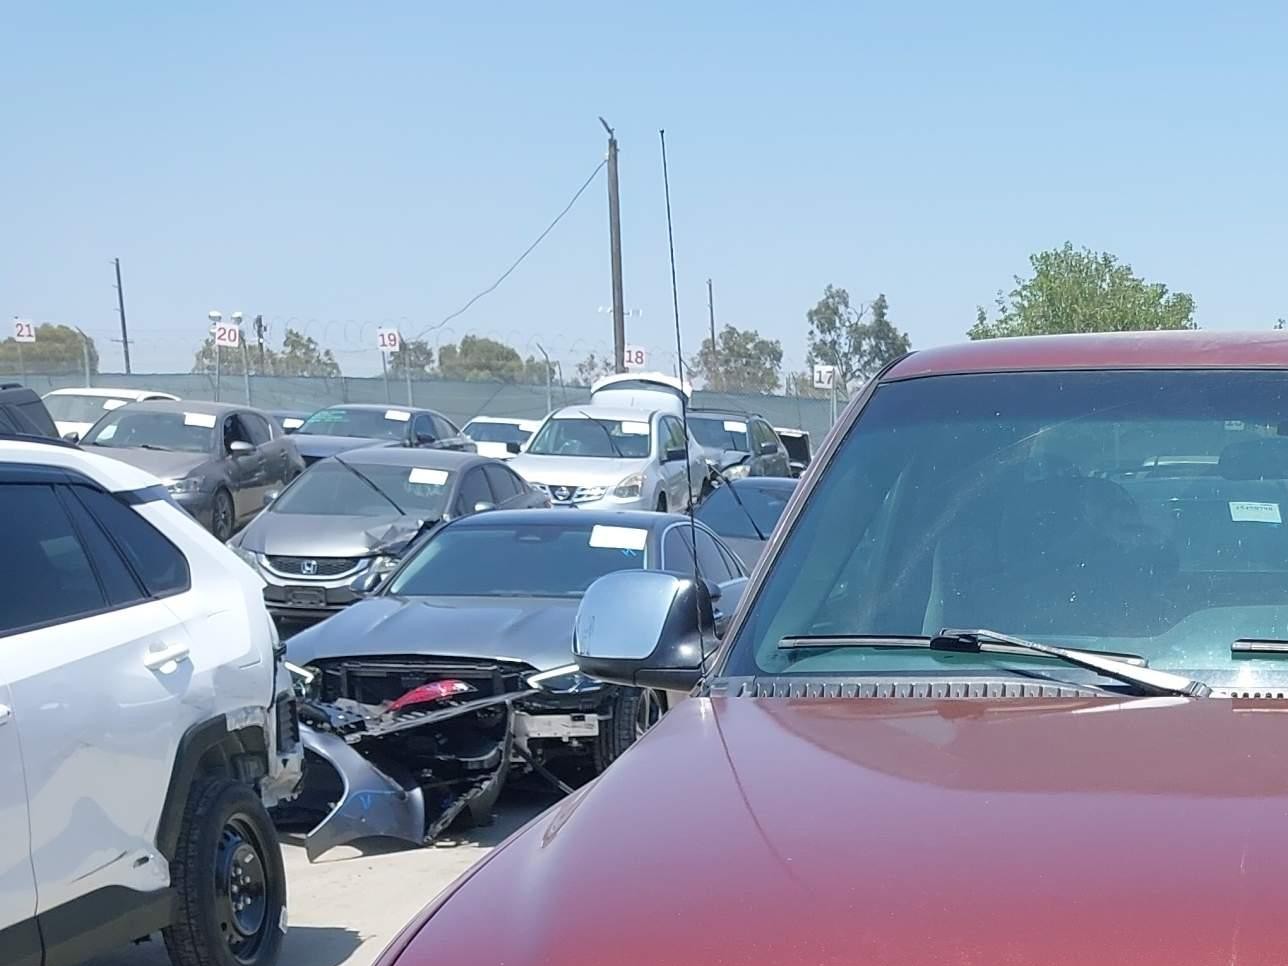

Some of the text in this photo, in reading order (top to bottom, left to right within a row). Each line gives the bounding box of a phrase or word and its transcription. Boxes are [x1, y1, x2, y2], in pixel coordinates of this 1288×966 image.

[16, 322, 35, 338] 21
[216, 326, 238, 343] 20
[379, 332, 398, 348] 19
[626, 349, 645, 365] 18
[815, 370, 834, 385] 17
